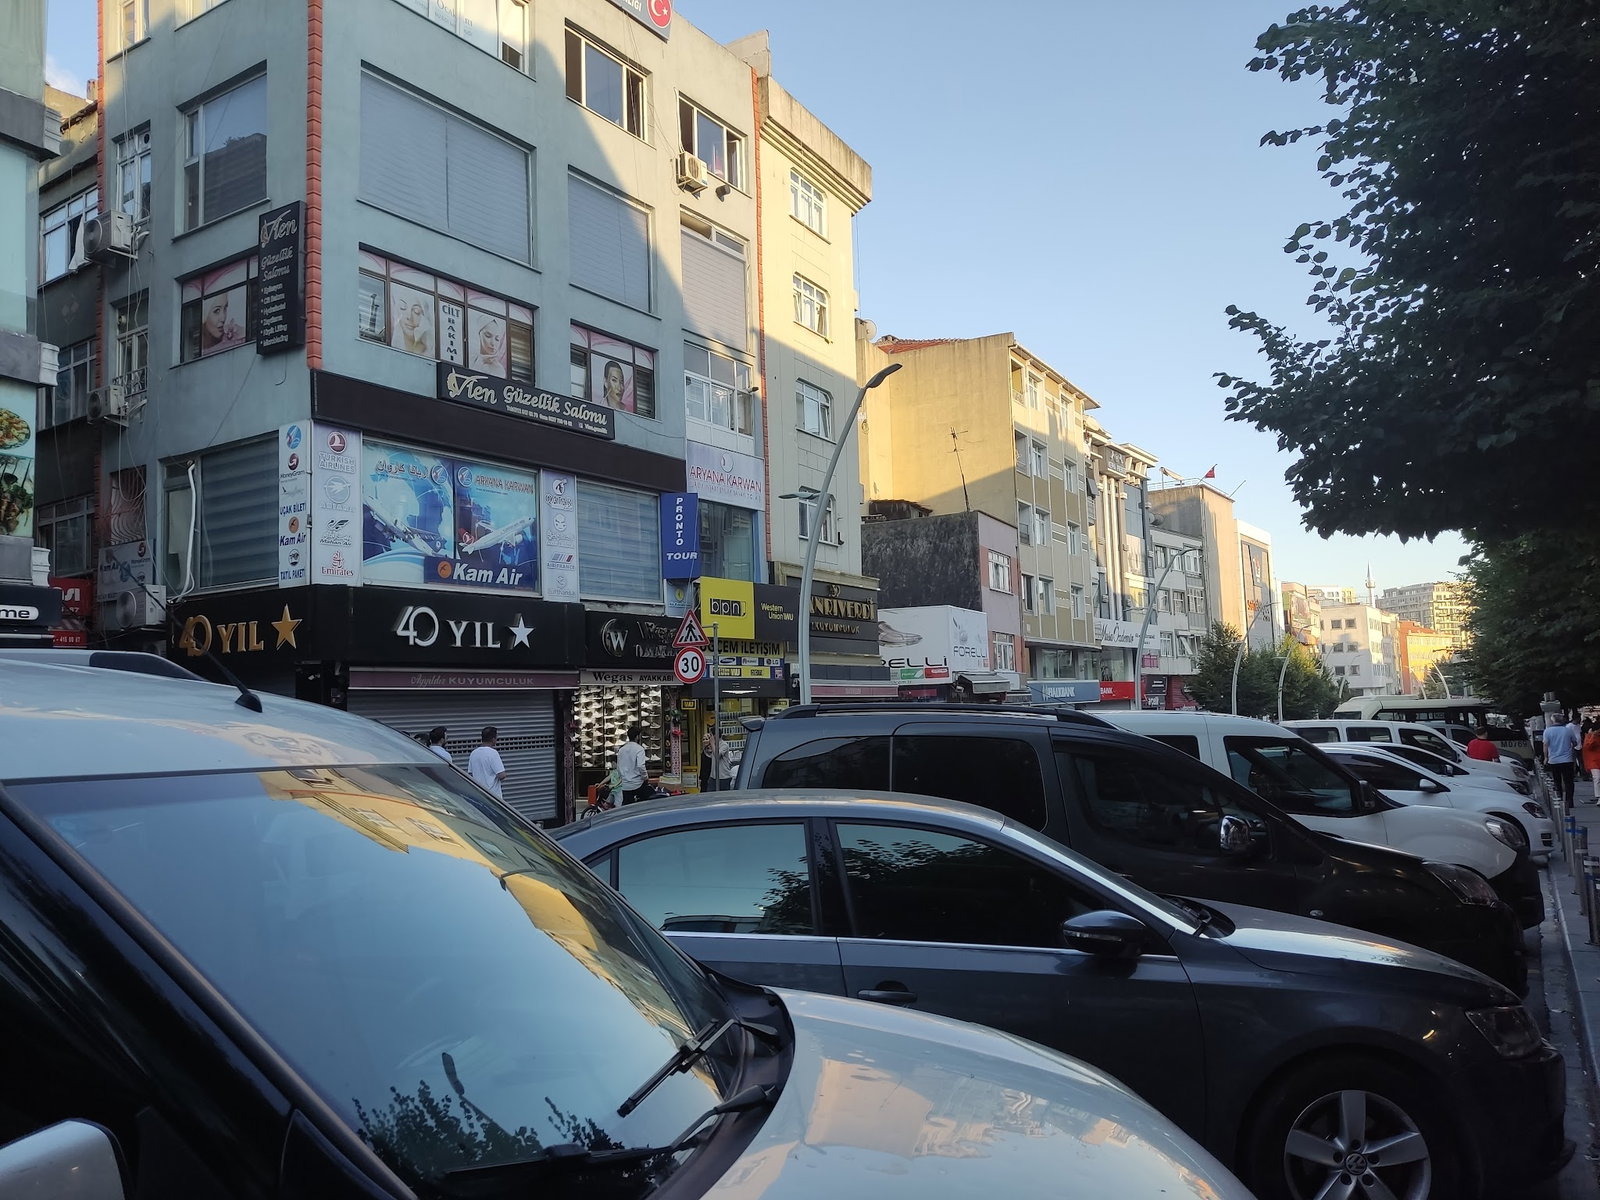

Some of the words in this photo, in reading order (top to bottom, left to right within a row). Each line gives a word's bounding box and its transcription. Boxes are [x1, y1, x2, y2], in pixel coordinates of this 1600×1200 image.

[502, 385, 561, 414] Güzellik
[562, 401, 608, 426] Salonu
[320, 453, 355, 465] TURKISH
[320, 461, 355, 473] AIRLINES
[689, 465, 725, 484] ARYANA
[726, 474, 762, 494] KARWAN
[675, 497, 685, 546] PRONTO
[280, 535, 296, 547] Kam
[296, 532, 306, 544] Air
[666, 551, 698, 561] TOUR
[321, 565, 354, 577] Emirates
[452, 562, 494, 584] Kam
[495, 567, 523, 586] Air
[761, 602, 784, 613] Western
[395, 605, 440, 648] 40
[447, 619, 501, 649] YIL
[216, 621, 263, 654] YIL
[681, 655, 700, 674] 30
[448, 676, 534, 686] KUYUMCULUK
[593, 671, 633, 684] Wegas
[638, 673, 674, 682] AYAKKABI
